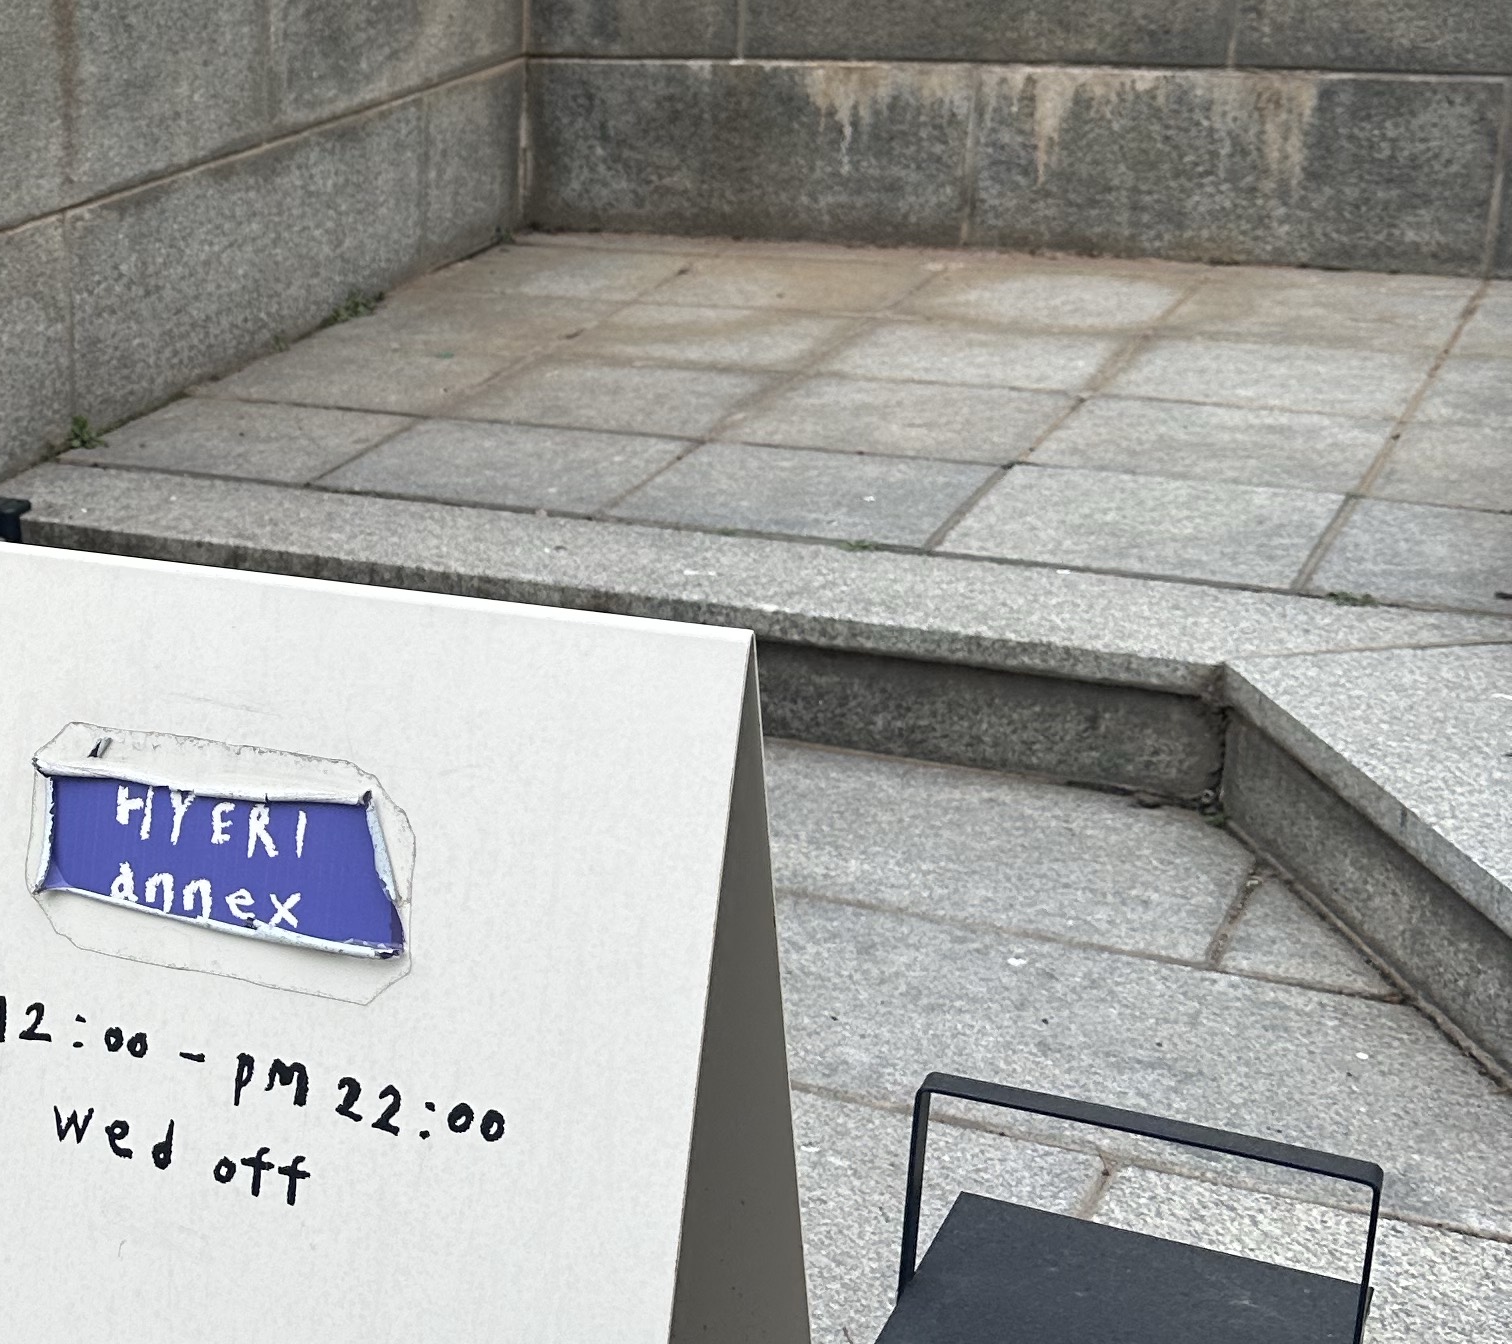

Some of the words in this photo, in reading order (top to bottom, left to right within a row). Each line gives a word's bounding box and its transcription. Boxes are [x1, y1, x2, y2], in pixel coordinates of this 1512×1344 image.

[115, 785, 308, 859] HYERI
[109, 861, 303, 928] annex
[213, 1146, 311, 1207] off
